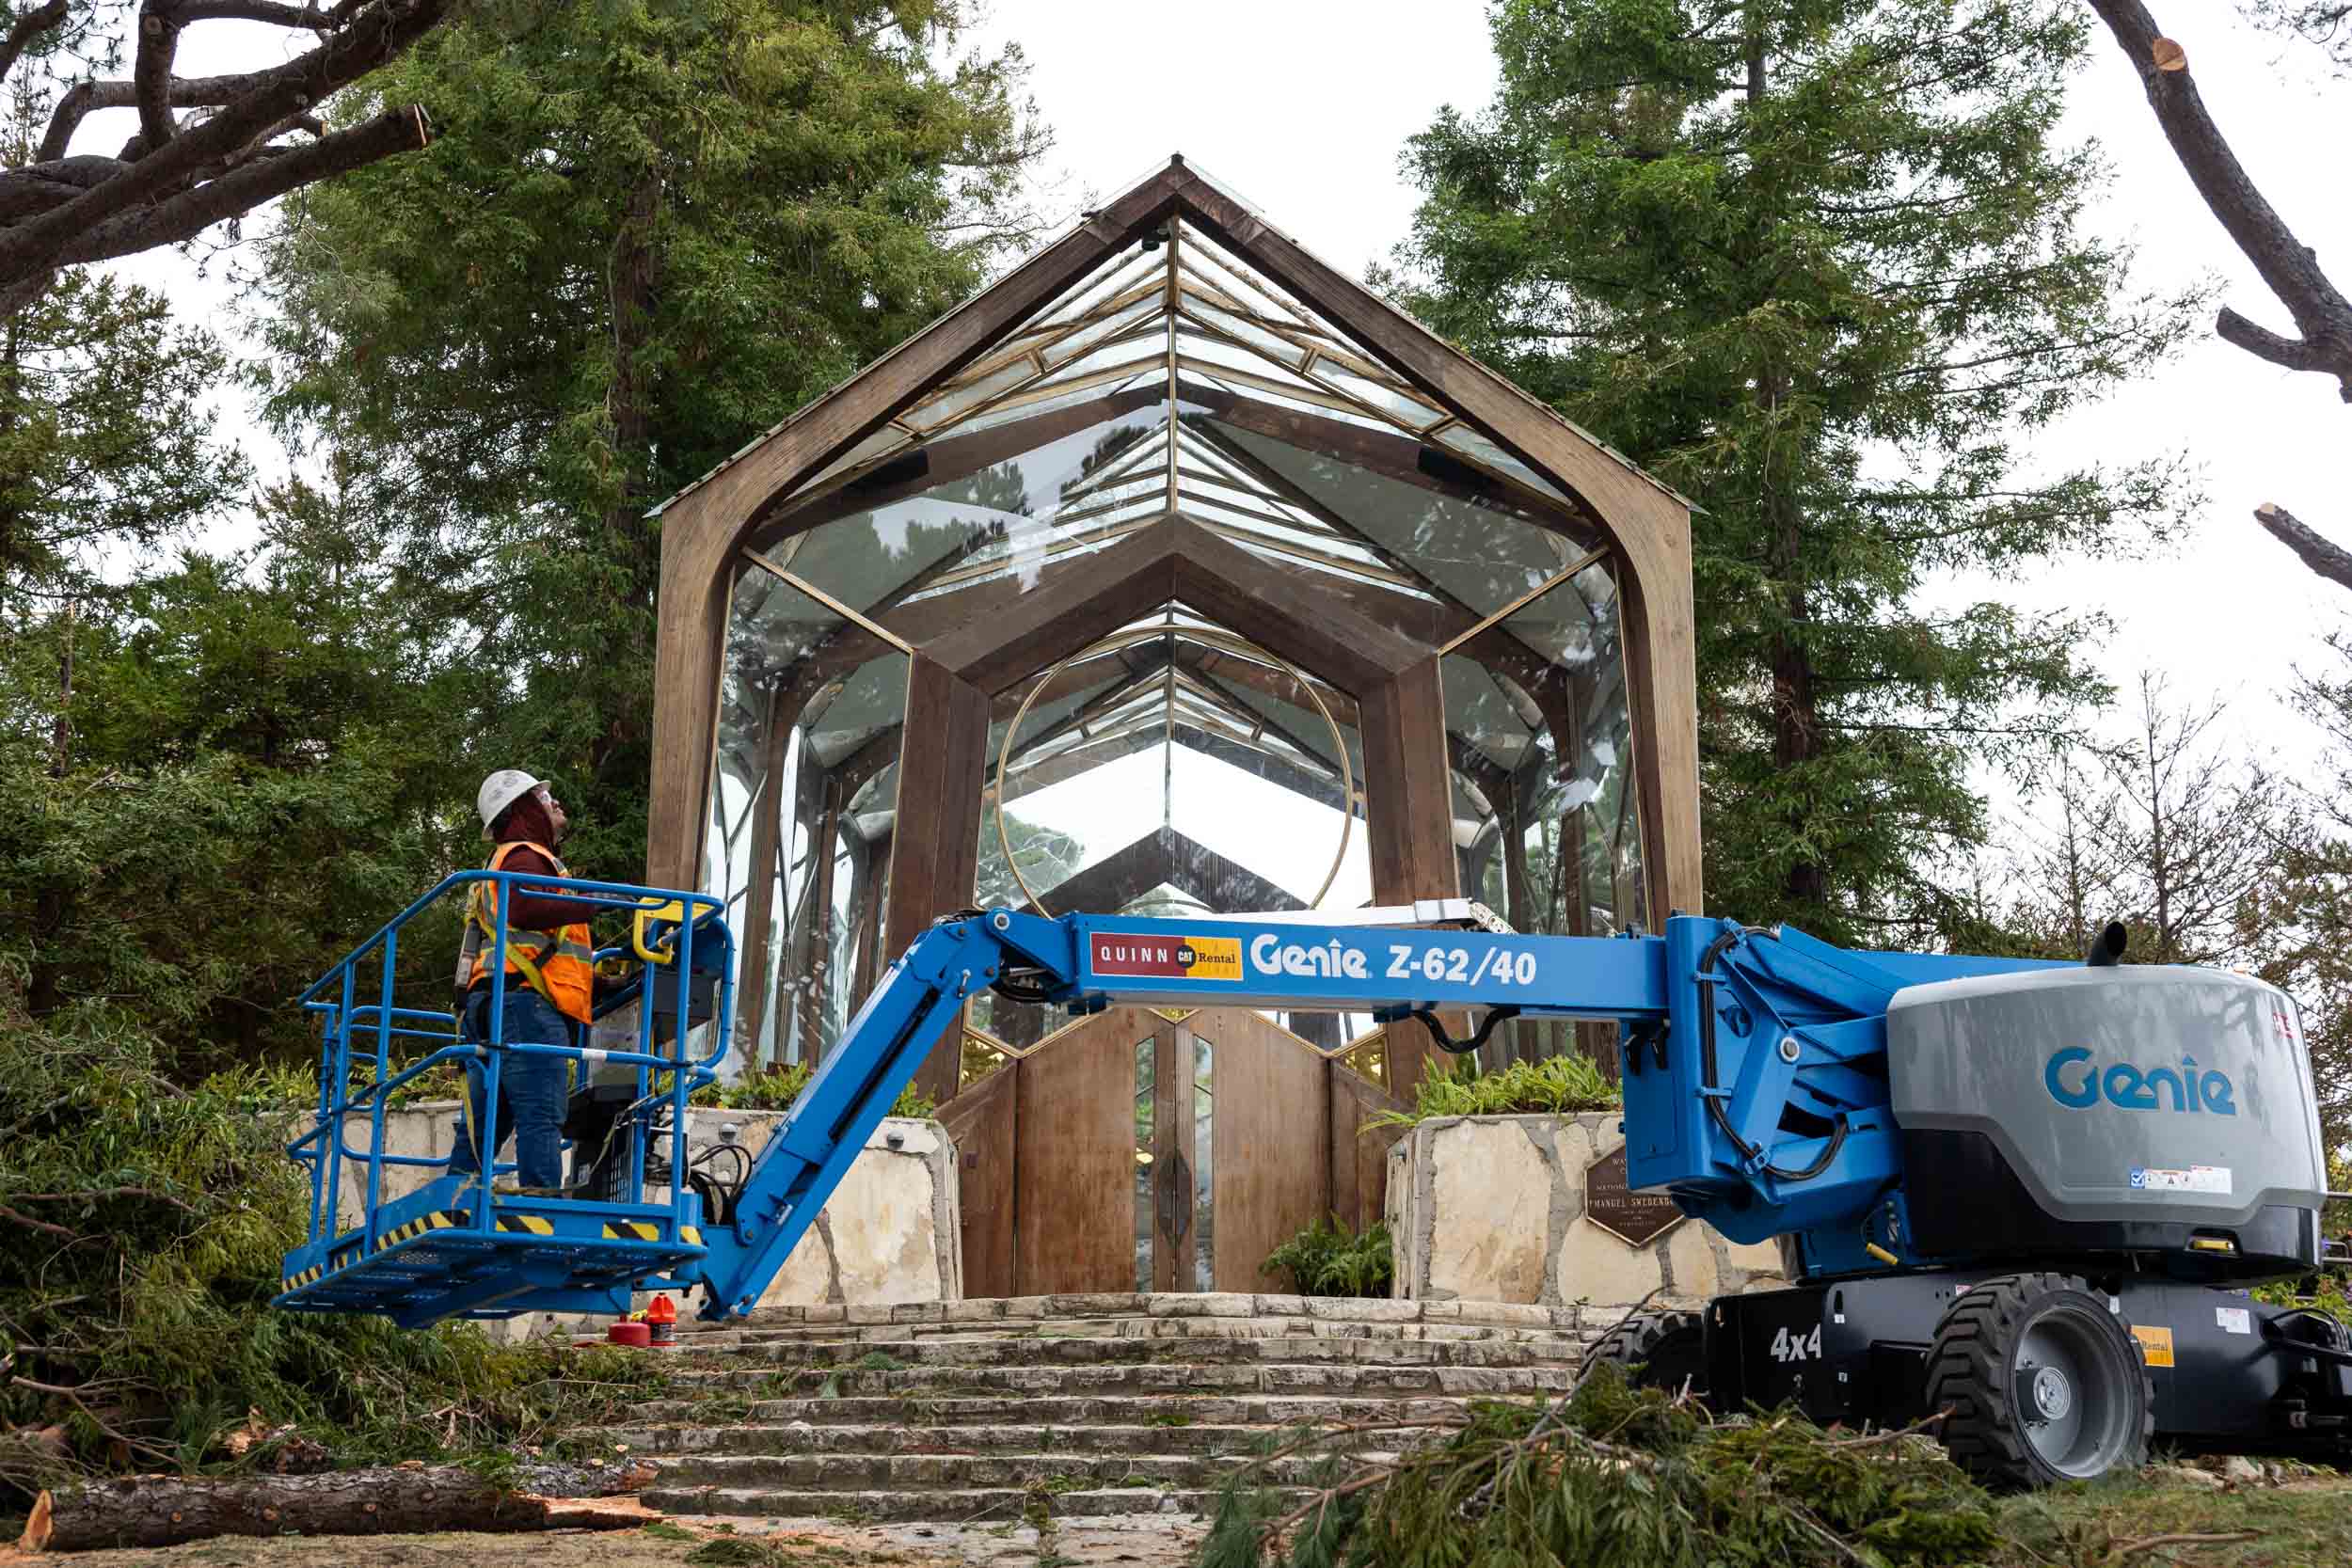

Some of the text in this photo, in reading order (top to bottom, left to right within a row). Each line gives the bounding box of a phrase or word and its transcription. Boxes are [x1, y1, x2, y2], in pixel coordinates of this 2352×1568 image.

[1101, 945, 1236, 964] QUINN CAT Rental
[1249, 933, 1537, 986] Genie Z-62/40
[2043, 1046, 2236, 1115] Genie
[1770, 1323, 1822, 1362] 4x4
